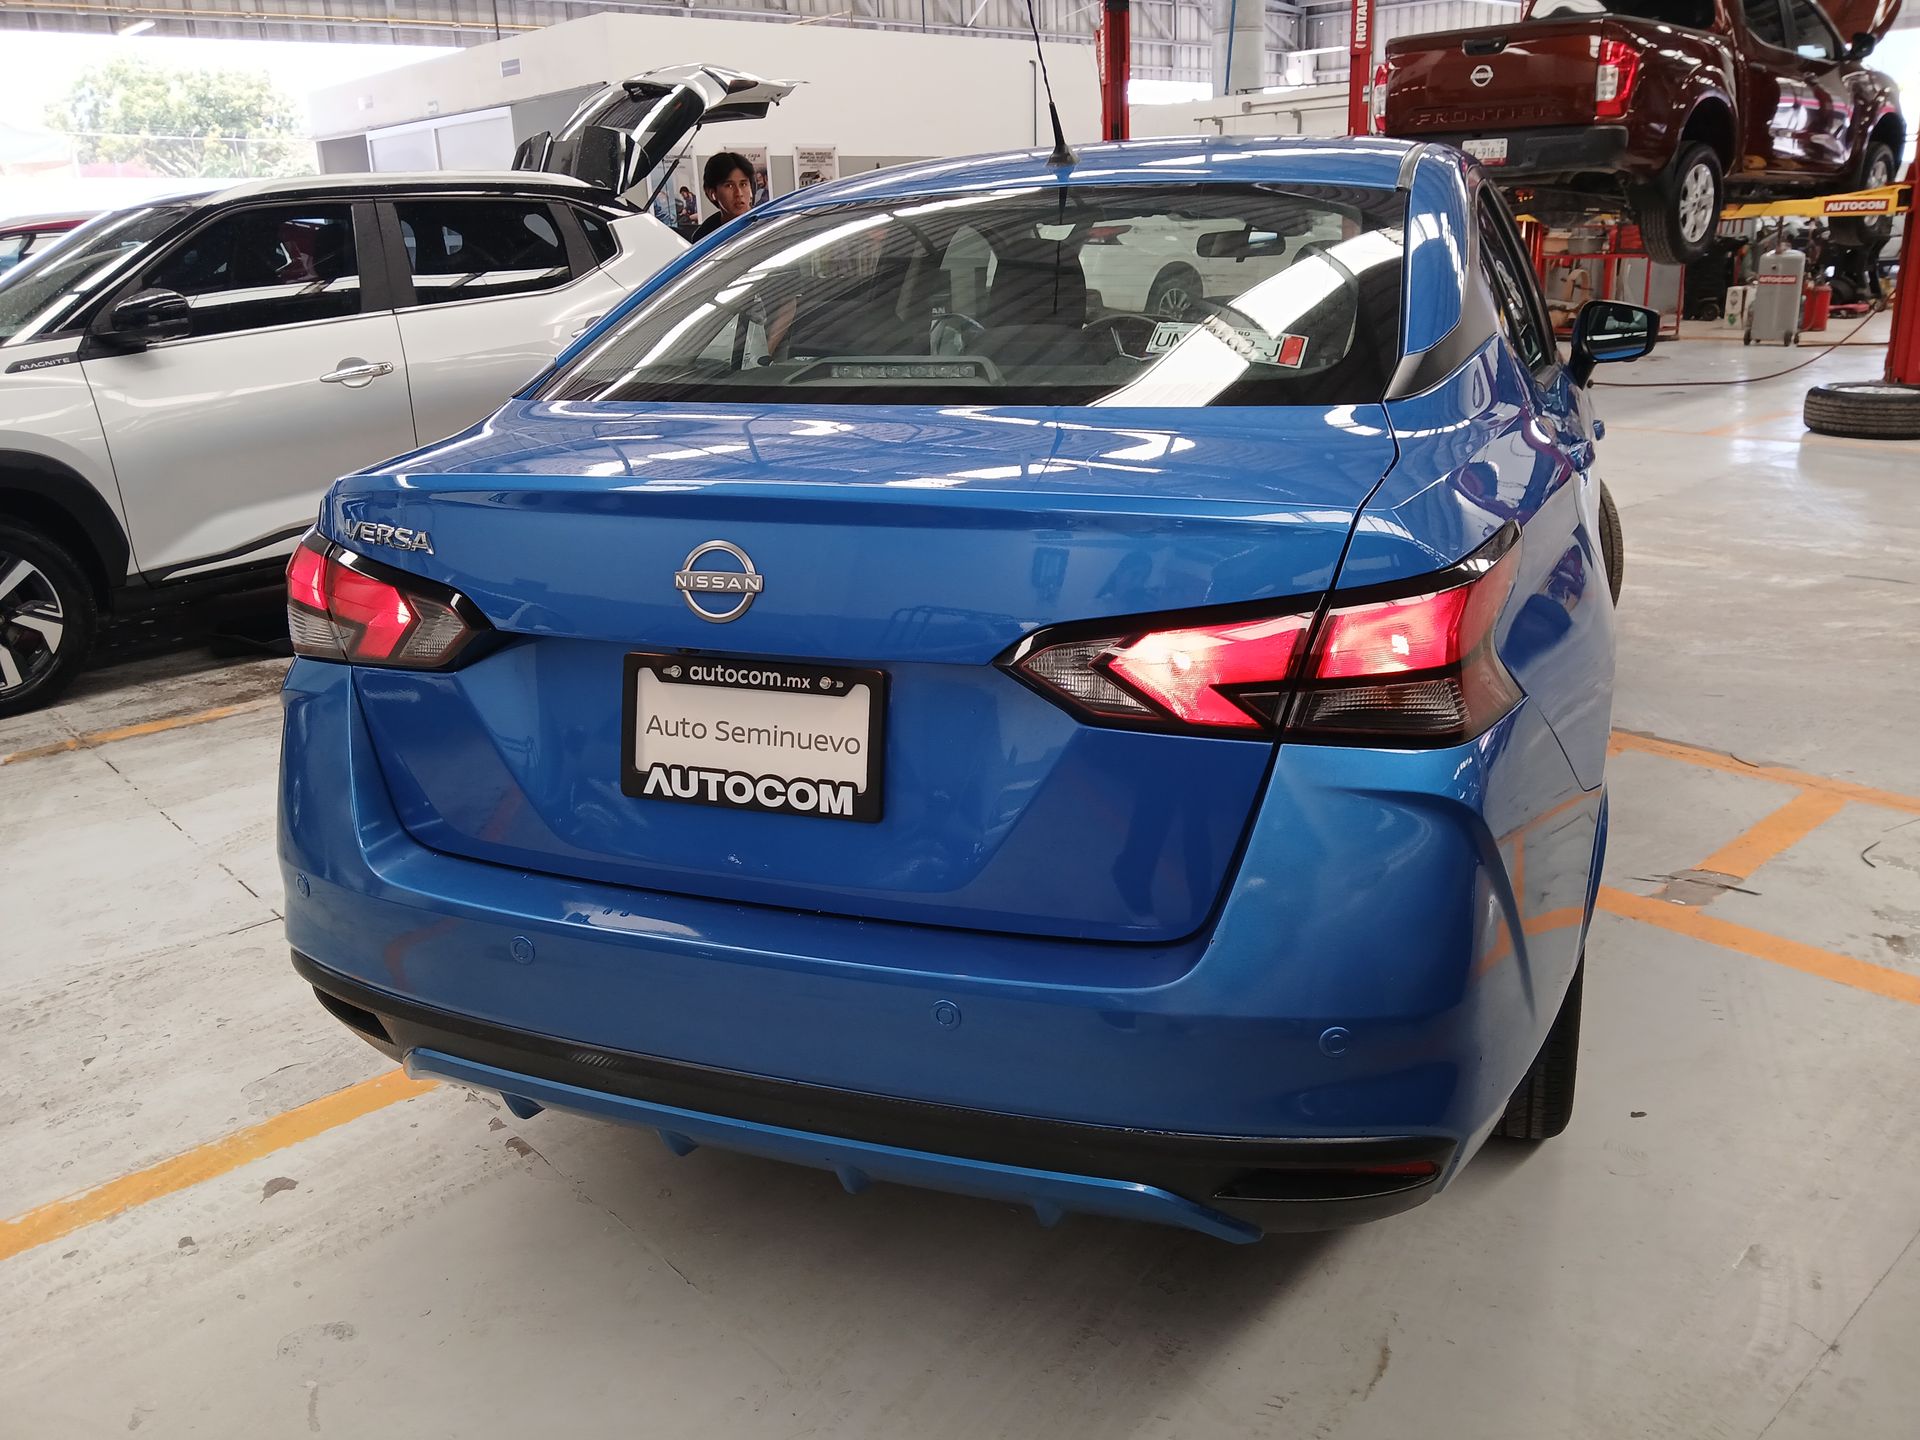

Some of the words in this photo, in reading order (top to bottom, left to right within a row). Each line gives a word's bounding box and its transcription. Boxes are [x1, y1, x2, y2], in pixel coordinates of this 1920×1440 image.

[1415, 105, 1563, 126] FRONTIER
[1826, 200, 1886, 211] AUTOCOM
[20, 357, 71, 370] MAGNITE
[344, 519, 435, 555] VERSA
[675, 574, 760, 590] NISSAN
[689, 664, 811, 689] autocom.mx
[645, 714, 708, 739] Auto
[714, 720, 861, 755] Seminuevo
[643, 766, 853, 815] AUTOCOM
